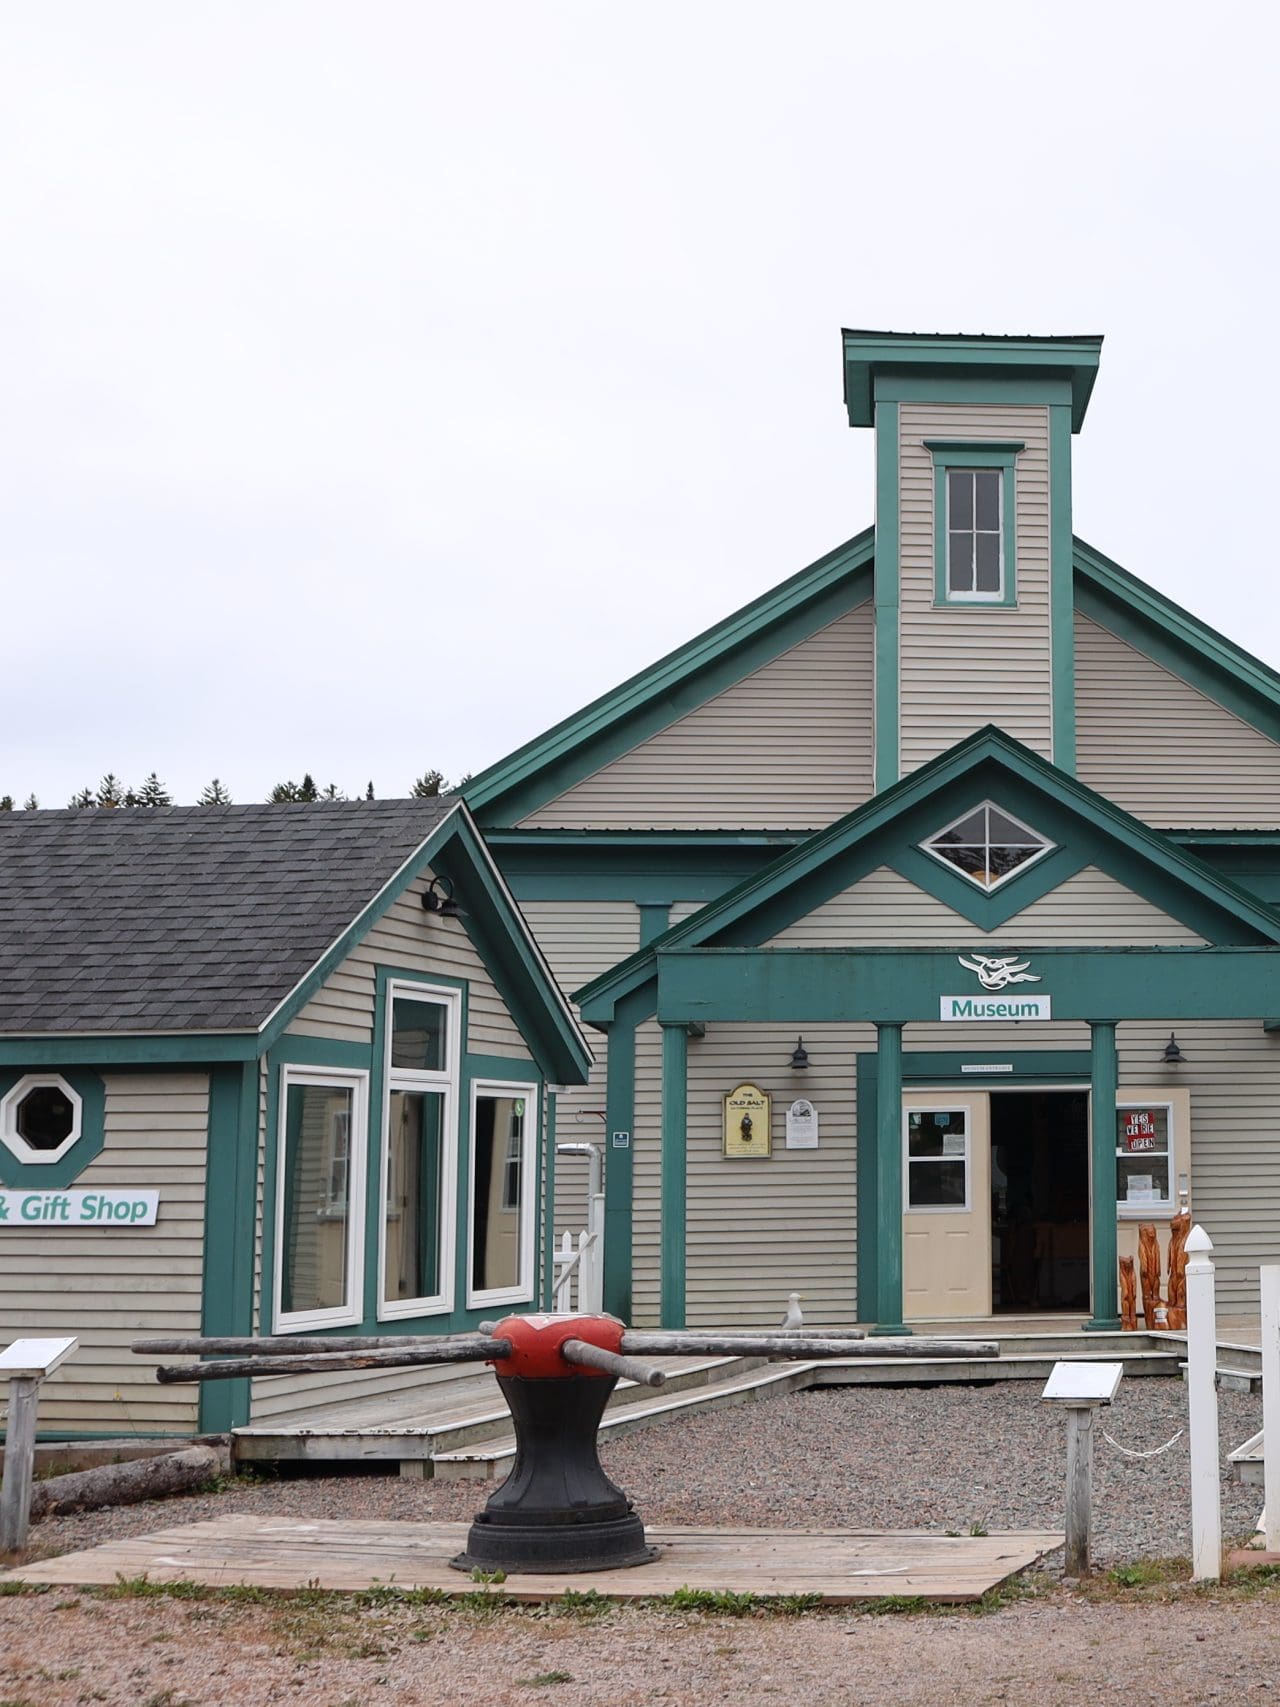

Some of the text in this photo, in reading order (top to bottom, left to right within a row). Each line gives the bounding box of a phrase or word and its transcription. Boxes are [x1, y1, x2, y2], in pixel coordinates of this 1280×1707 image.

[951, 999, 1040, 1017] Museum
[1131, 1114, 1148, 1124] YES
[1132, 1138, 1154, 1149] OPEN
[21, 1195, 71, 1221] Gift
[80, 1194, 148, 1223] Shop
